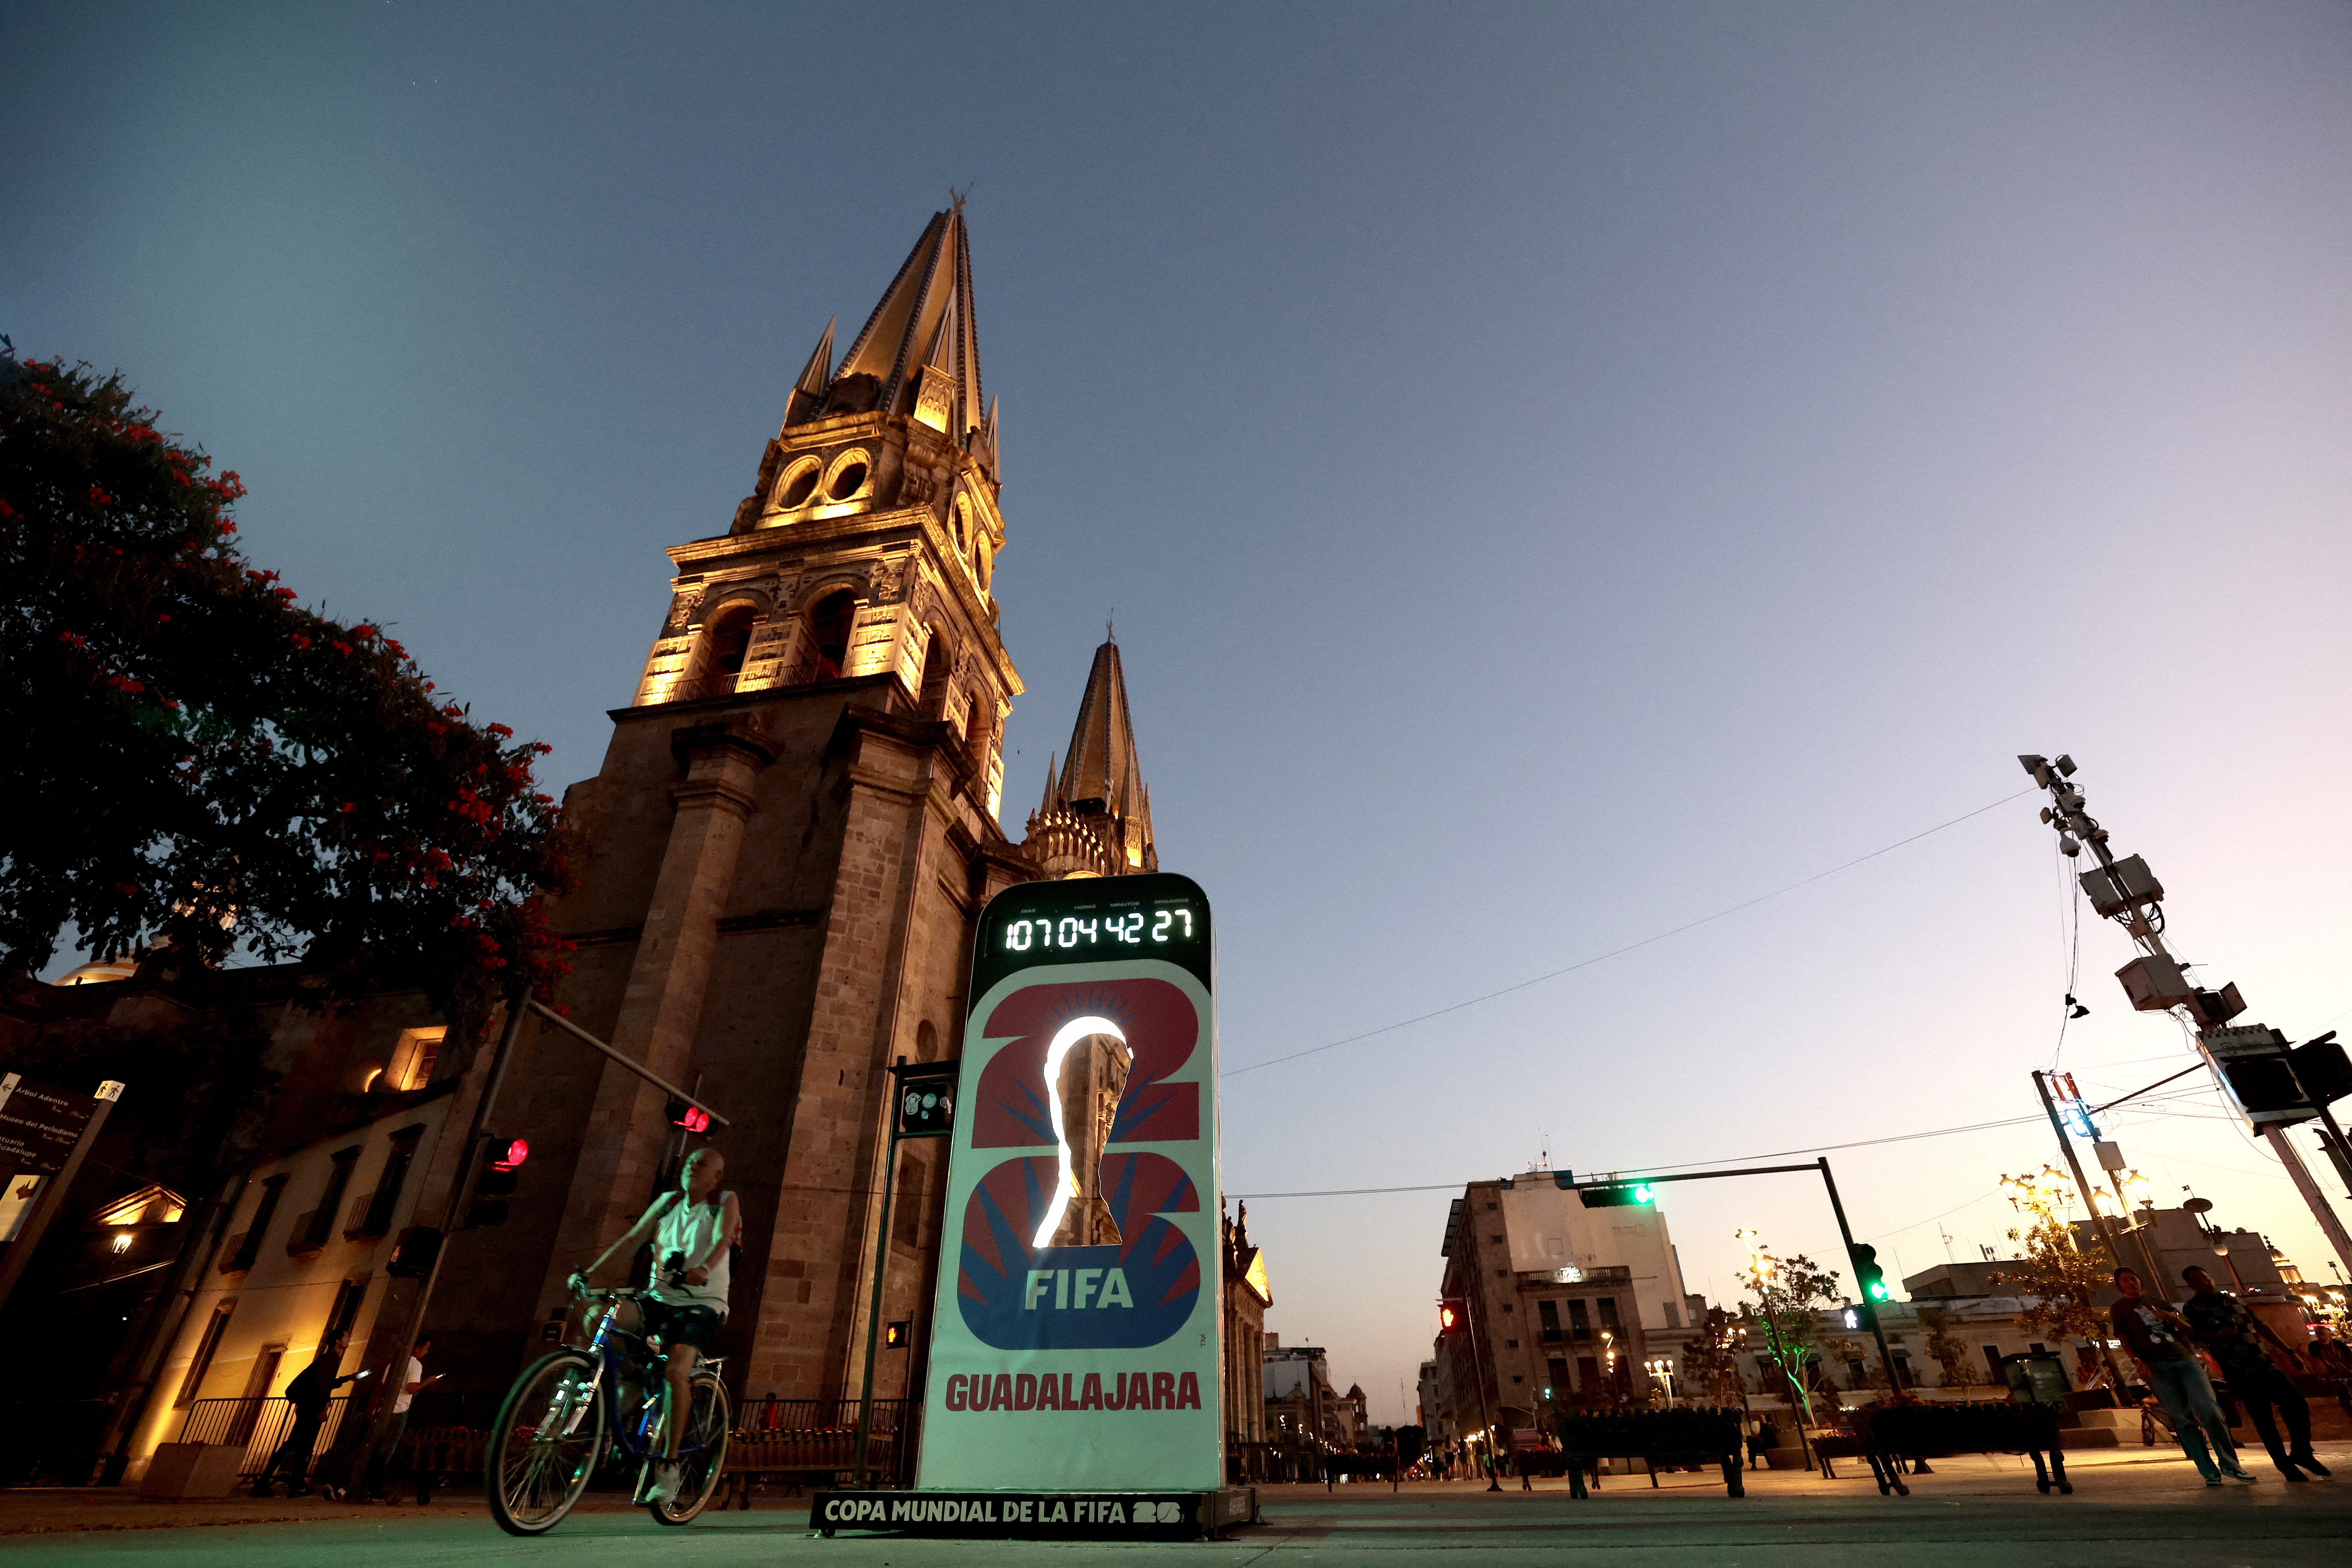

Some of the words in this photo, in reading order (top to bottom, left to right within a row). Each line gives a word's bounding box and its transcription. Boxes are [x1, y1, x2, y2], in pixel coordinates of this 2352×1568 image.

[1006, 919, 1051, 950] 107
[1058, 917, 1097, 947] 04
[1105, 913, 1143, 943] 42
[1152, 909, 1191, 941] 27
[38, 1094, 68, 1106] Adentro
[0, 1114, 24, 1124] Museo
[39, 1123, 78, 1138] Periodismo
[1025, 1268, 1134, 1310] FIFA
[1201, 1334, 1206, 1348] TM
[946, 1372, 1201, 1412] GUADALAJARA
[825, 1500, 886, 1521] COPA
[892, 1501, 997, 1522] MUNDIAL
[1003, 1501, 1034, 1522] DE
[1038, 1501, 1069, 1522] LA
[1074, 1501, 1126, 1523] FIFA
[1133, 1502, 1180, 1523] 26
